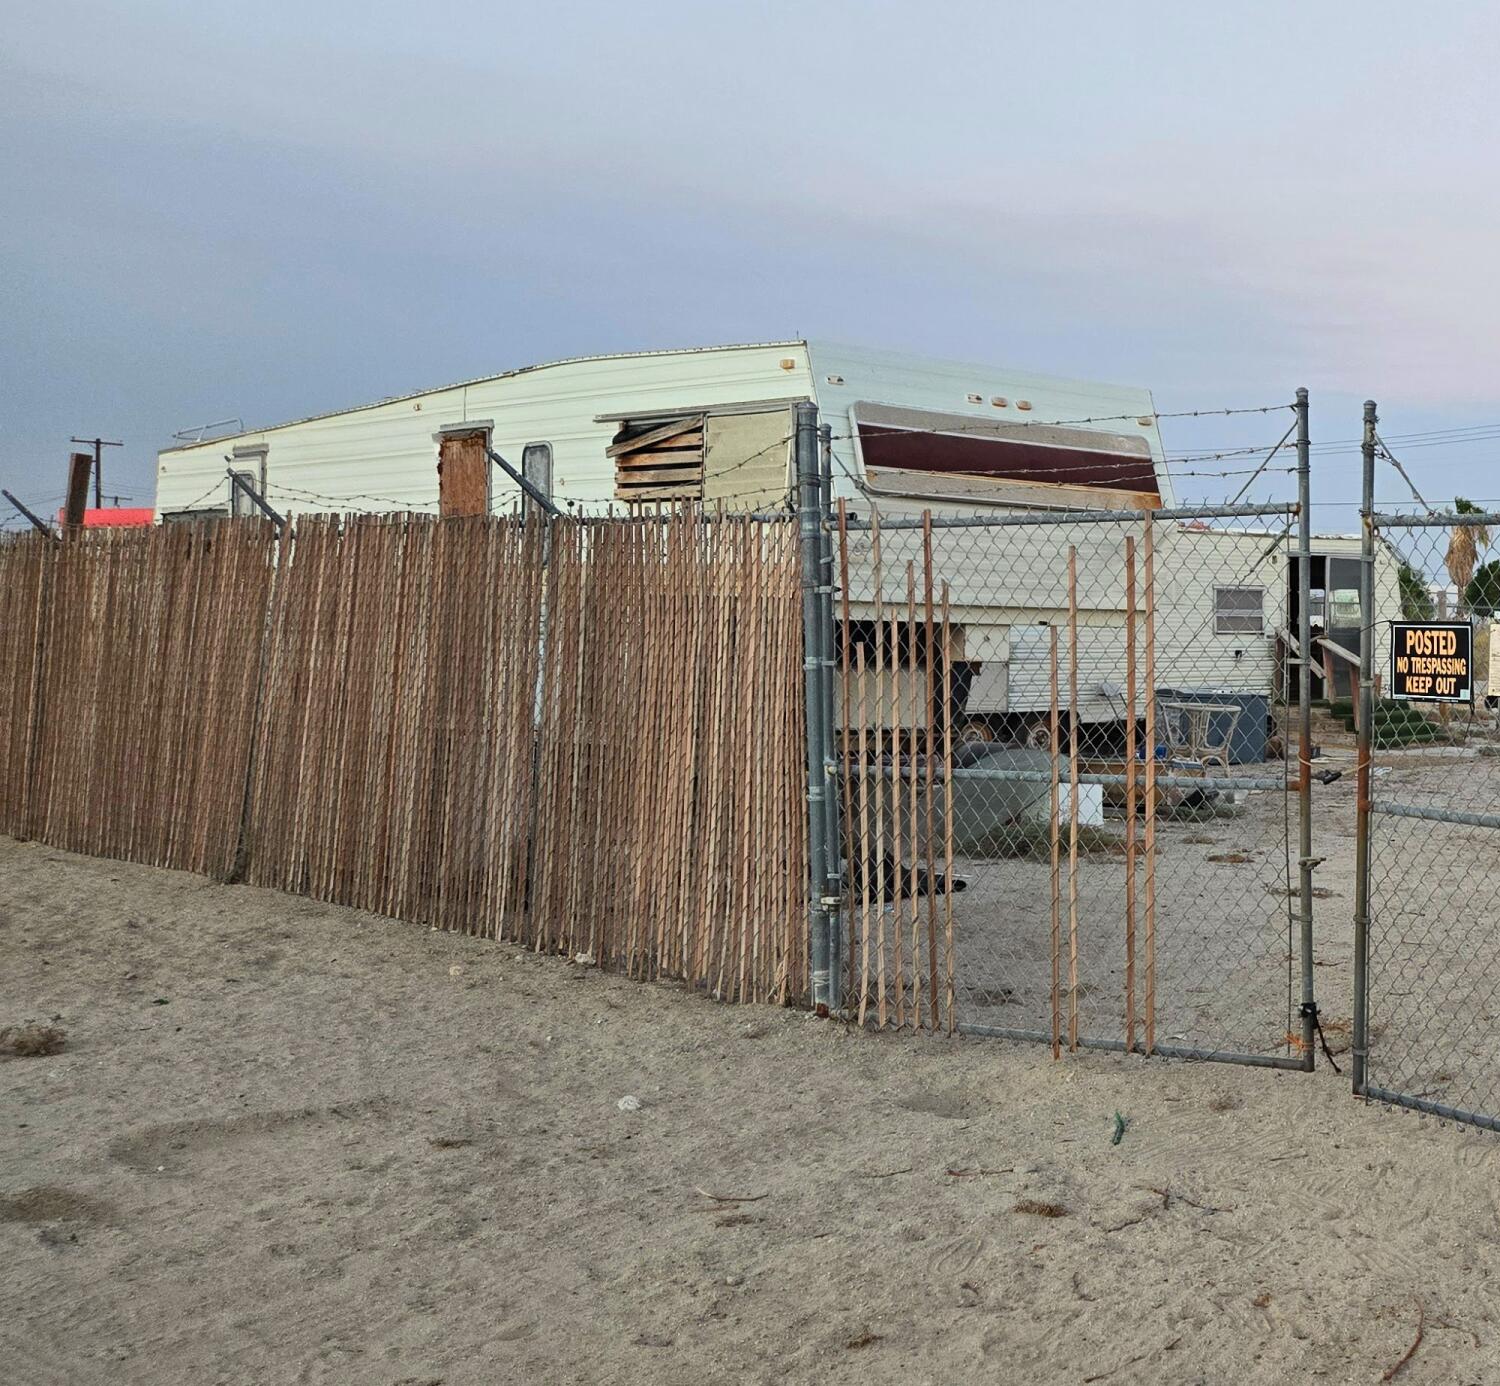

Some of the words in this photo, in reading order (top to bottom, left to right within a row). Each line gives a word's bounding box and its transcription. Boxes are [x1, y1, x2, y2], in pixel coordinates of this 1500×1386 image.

[1406, 630, 1457, 655] POSTED
[1396, 656, 1409, 673] NO
[1411, 657, 1466, 675] TRESPASSING
[1406, 676, 1433, 694] KEEP
[1435, 677, 1457, 695] OUT
